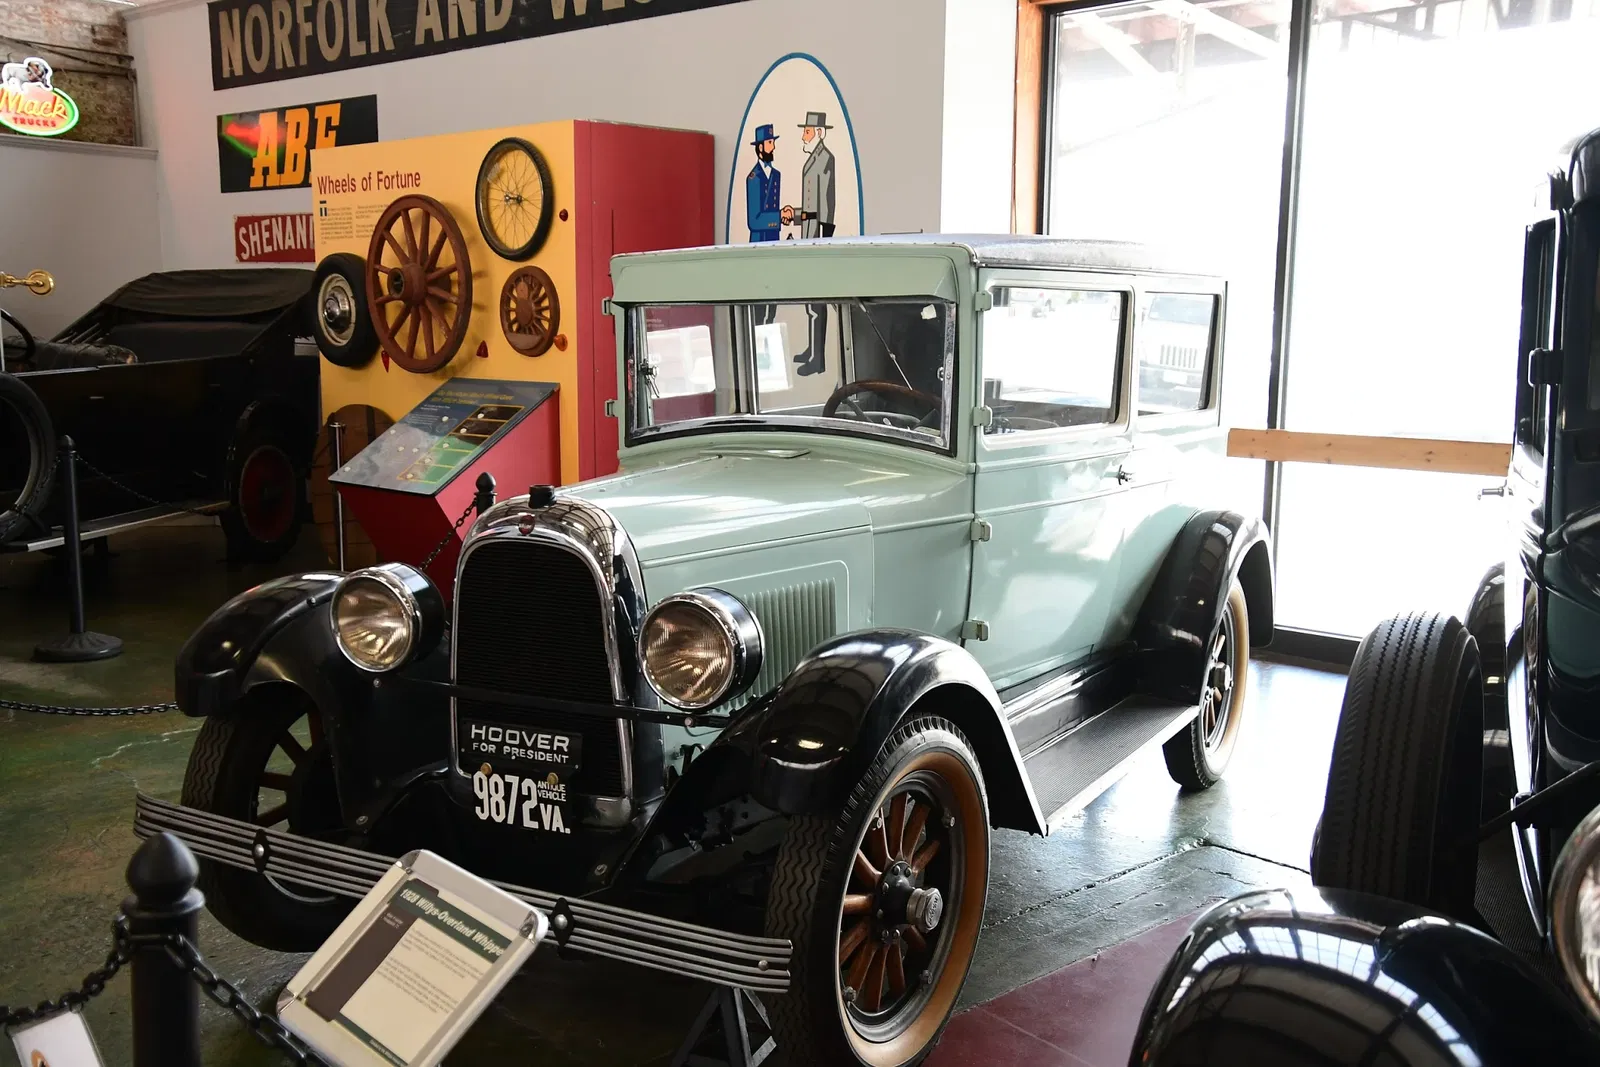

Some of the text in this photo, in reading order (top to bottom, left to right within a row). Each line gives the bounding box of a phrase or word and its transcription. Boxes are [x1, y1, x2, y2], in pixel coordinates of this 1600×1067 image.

[218, 0, 395, 78] NORFOLK
[0, 88, 68, 120] Mack
[12, 116, 57, 128] TRUCKS
[316, 170, 421, 195] Wheels of Fortune
[470, 724, 570, 752] HOOVER
[472, 742, 569, 764] FOR PRESIDENT
[473, 770, 539, 829] 9872
[537, 780, 566, 793] ANTIQUE
[537, 789, 567, 802] VEHICLE
[539, 803, 571, 834] VA.
[399, 888, 420, 904] 1928
[415, 897, 476, 938] Willys-Overland
